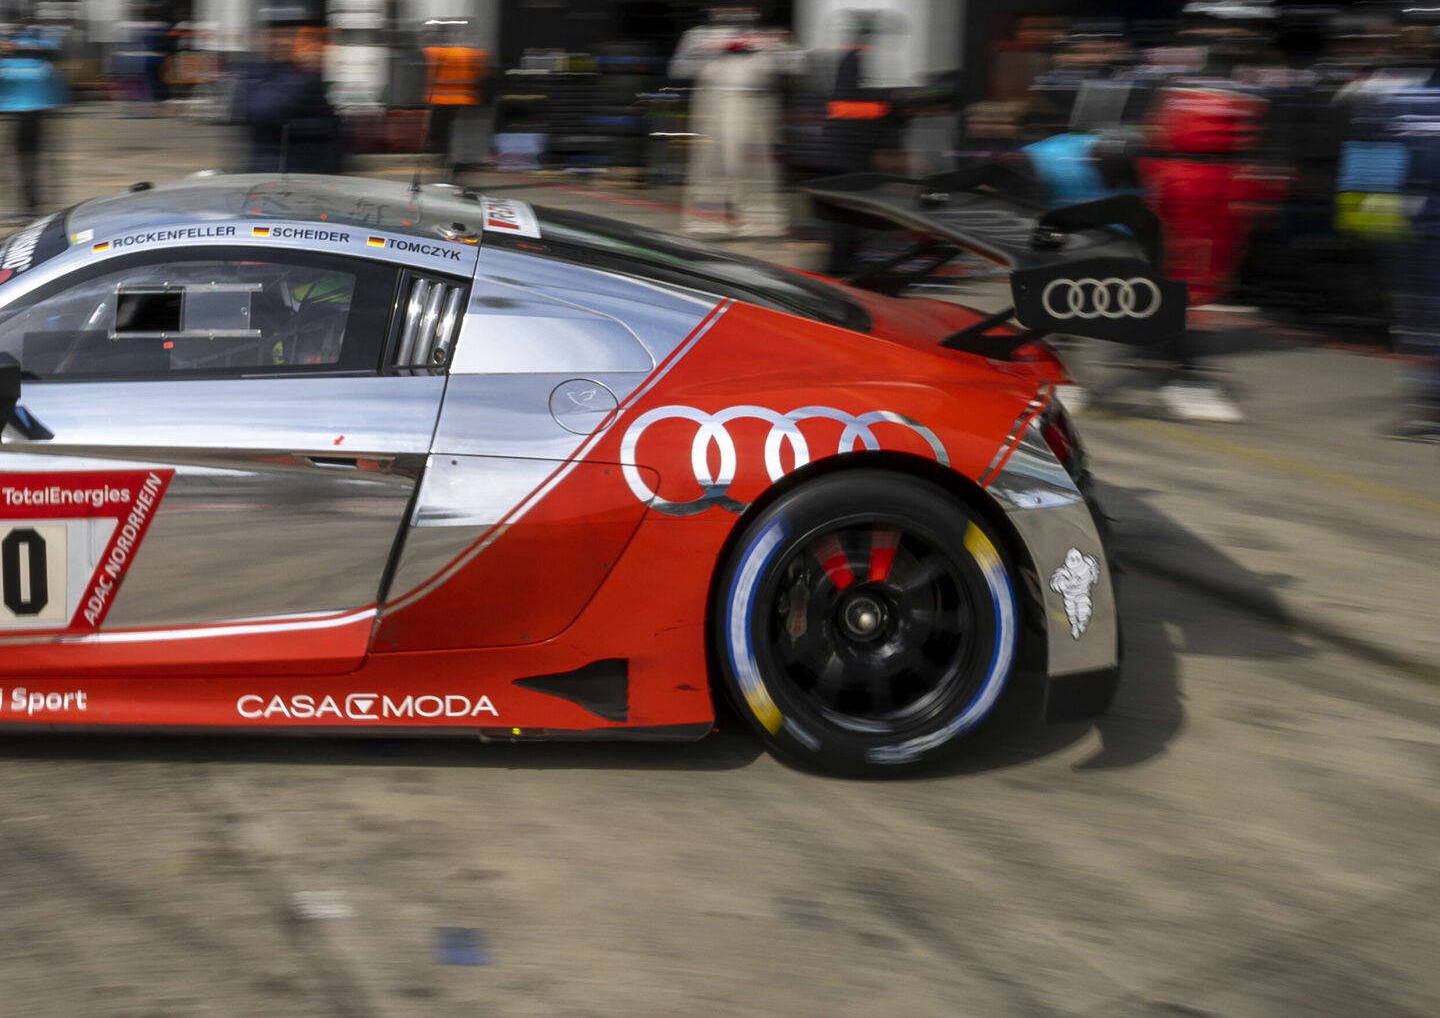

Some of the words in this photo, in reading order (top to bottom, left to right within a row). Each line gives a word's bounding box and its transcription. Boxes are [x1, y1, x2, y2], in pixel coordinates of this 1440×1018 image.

[112, 226, 236, 249] ROCKENFELLER
[272, 227, 350, 244] SCHEIDER
[388, 238, 461, 262] TOMCZYK
[2, 484, 131, 508] TotalEnergies
[83, 573, 113, 627] ADAC
[104, 471, 163, 580] NORDRHEIN
[10, 686, 88, 717] Sport
